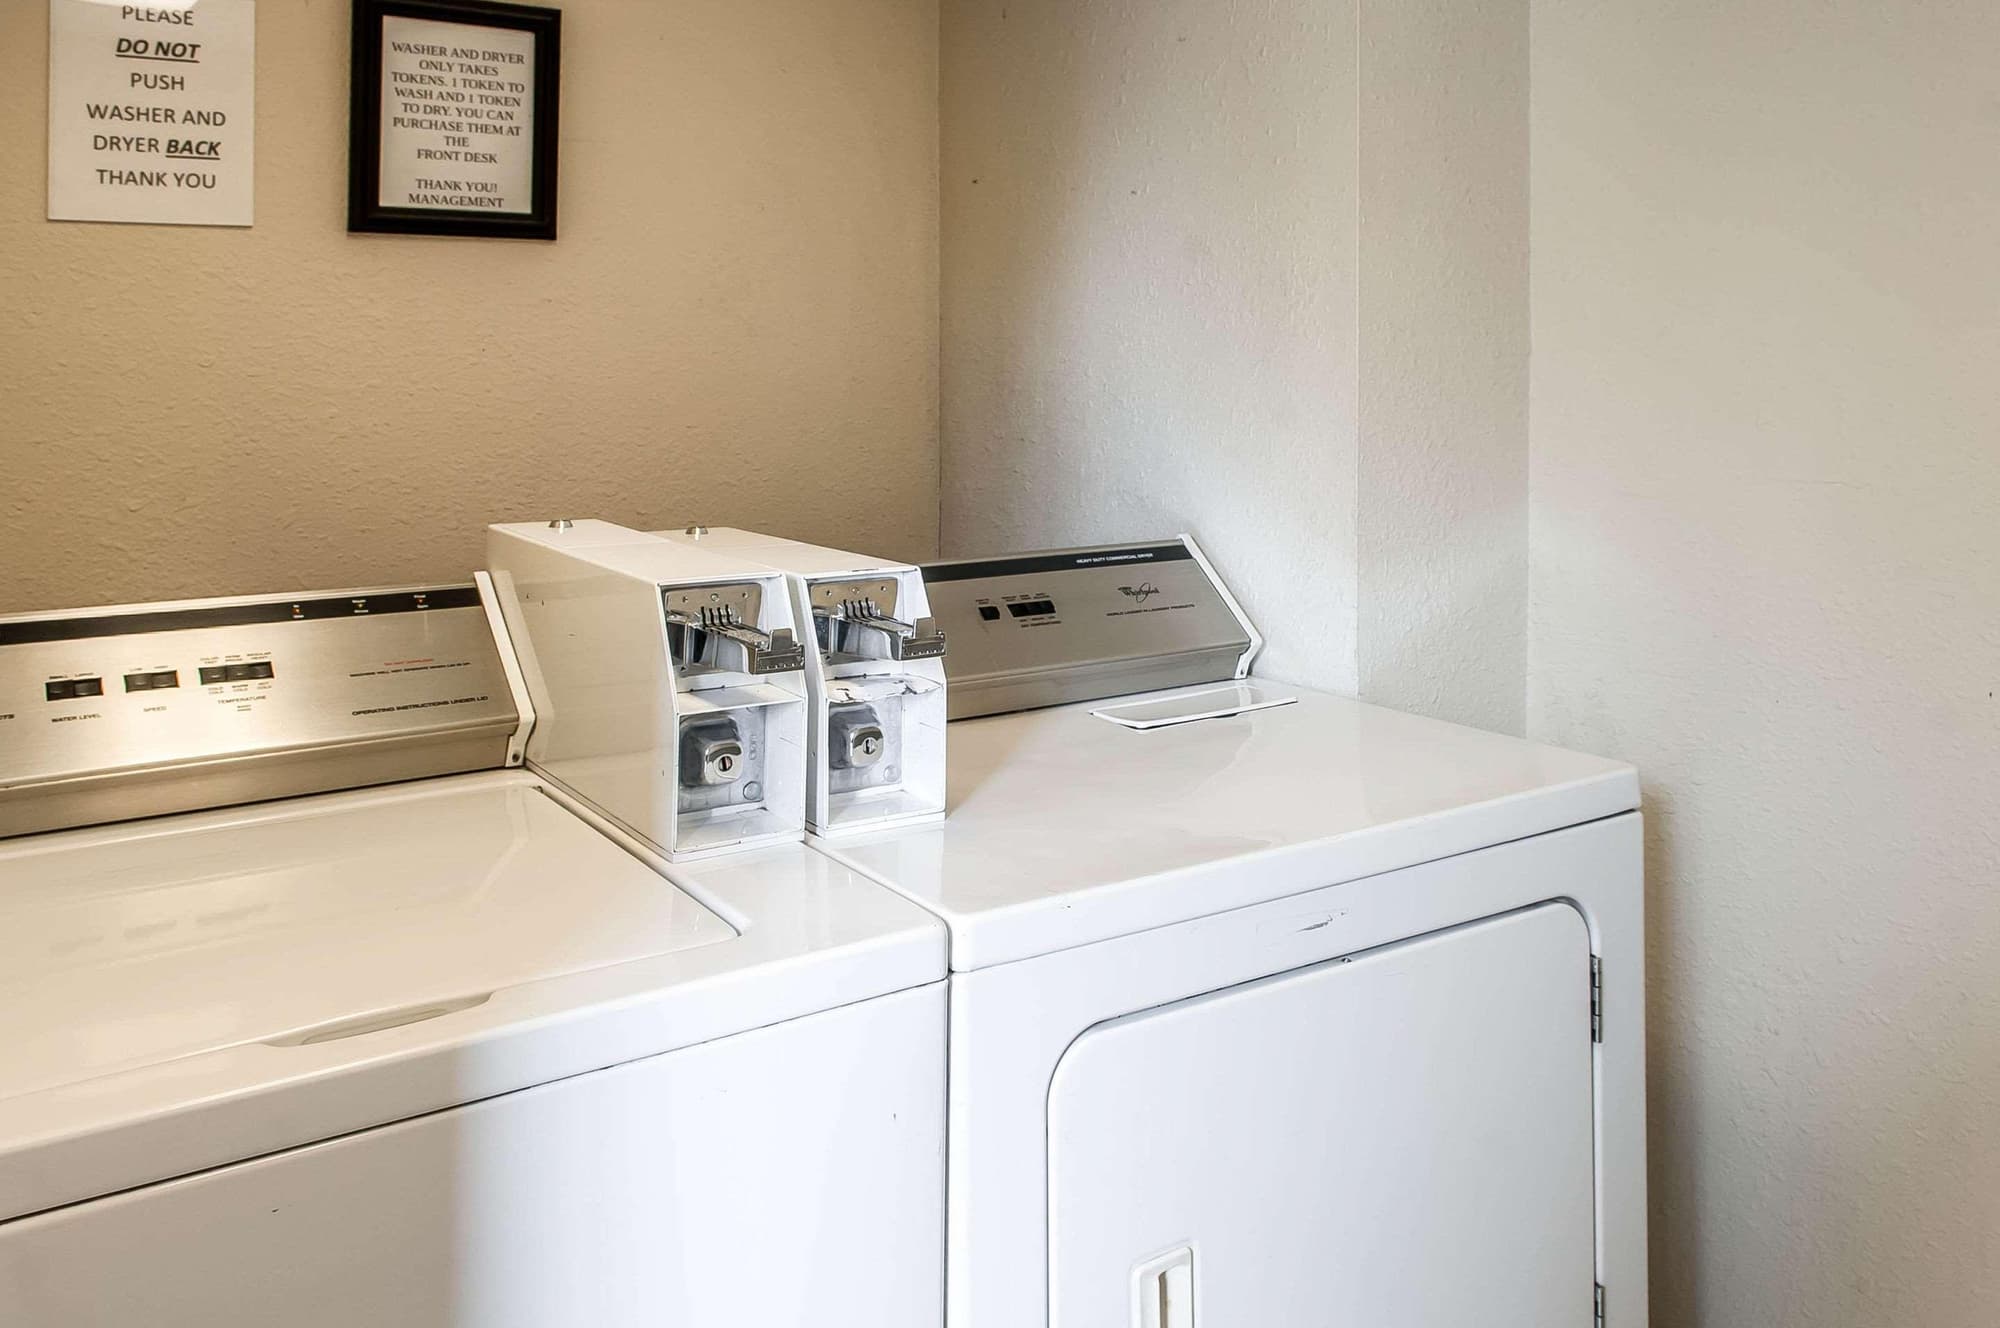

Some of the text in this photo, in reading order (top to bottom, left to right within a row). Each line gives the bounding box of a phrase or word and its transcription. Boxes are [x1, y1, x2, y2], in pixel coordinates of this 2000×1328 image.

[122, 5, 194, 26] PLEASE
[116, 38, 201, 60] DO NOT
[391, 41, 525, 65] WASHER AND DRYER
[419, 59, 499, 77] ONLY TAKES
[130, 72, 185, 91] PUSH
[391, 72, 448, 87] TOKENS.
[461, 78, 504, 92] TOKEN
[508, 82, 525, 93] TO
[394, 87, 433, 100] WASH
[437, 91, 465, 103] AND
[478, 94, 521, 107] TOKEN
[86, 103, 226, 127] WASHER AND
[401, 102, 420, 114] TO
[455, 107, 484, 119] YOU
[486, 109, 514, 121] CAN
[393, 117, 522, 137] PURCHASE THEM AT
[93, 134, 222, 157] DRYER BACK
[444, 136, 470, 147] THE
[417, 148, 498, 164] FRONT DESK
[96, 168, 216, 189] THANK YOU
[416, 178, 497, 193] THANK YOU!
[408, 193, 504, 208] MANAGEMENT
[351, 706, 395, 717] OPERATING
[396, 700, 450, 711] INSTRUCTIONS
[450, 697, 476, 705] UNDER
[51, 715, 77, 723] WATER
